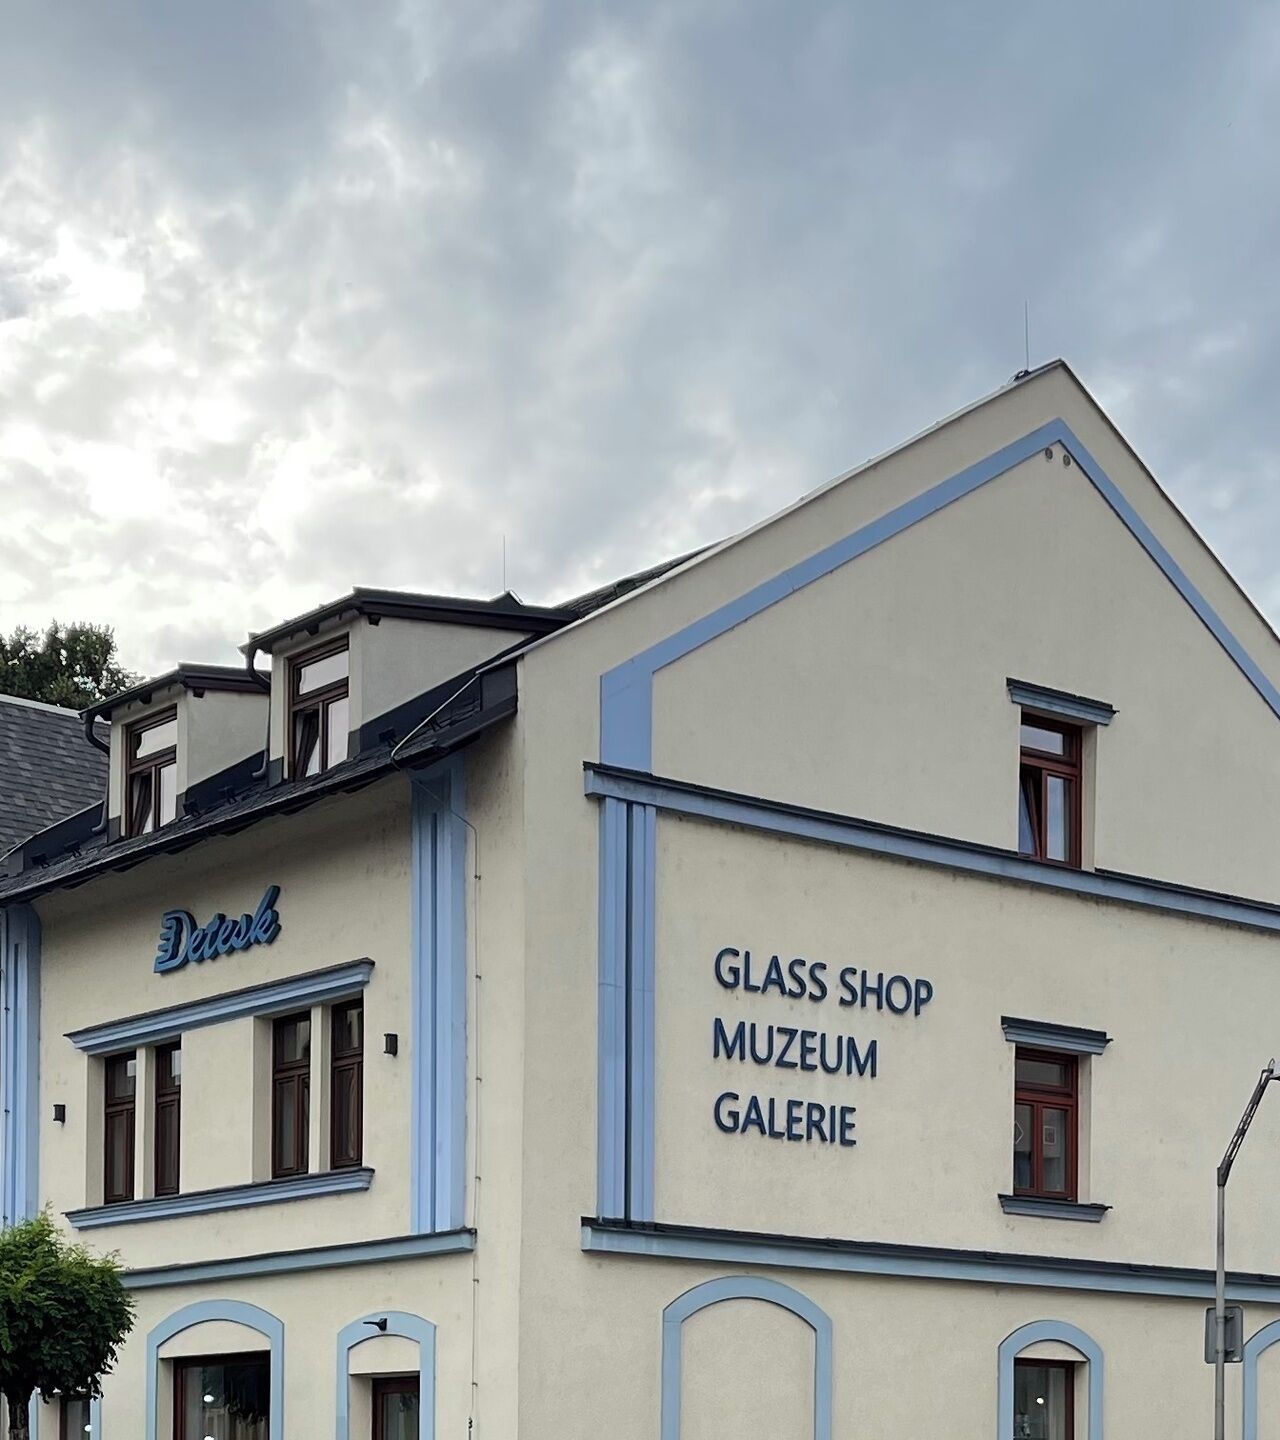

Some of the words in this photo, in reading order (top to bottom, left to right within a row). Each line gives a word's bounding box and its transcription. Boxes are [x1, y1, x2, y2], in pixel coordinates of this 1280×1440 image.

[715, 948, 827, 1002] GLASS
[839, 967, 933, 1016] SHOP
[713, 1018, 877, 1079] MUZEUM
[714, 1092, 856, 1147] GALERIE
